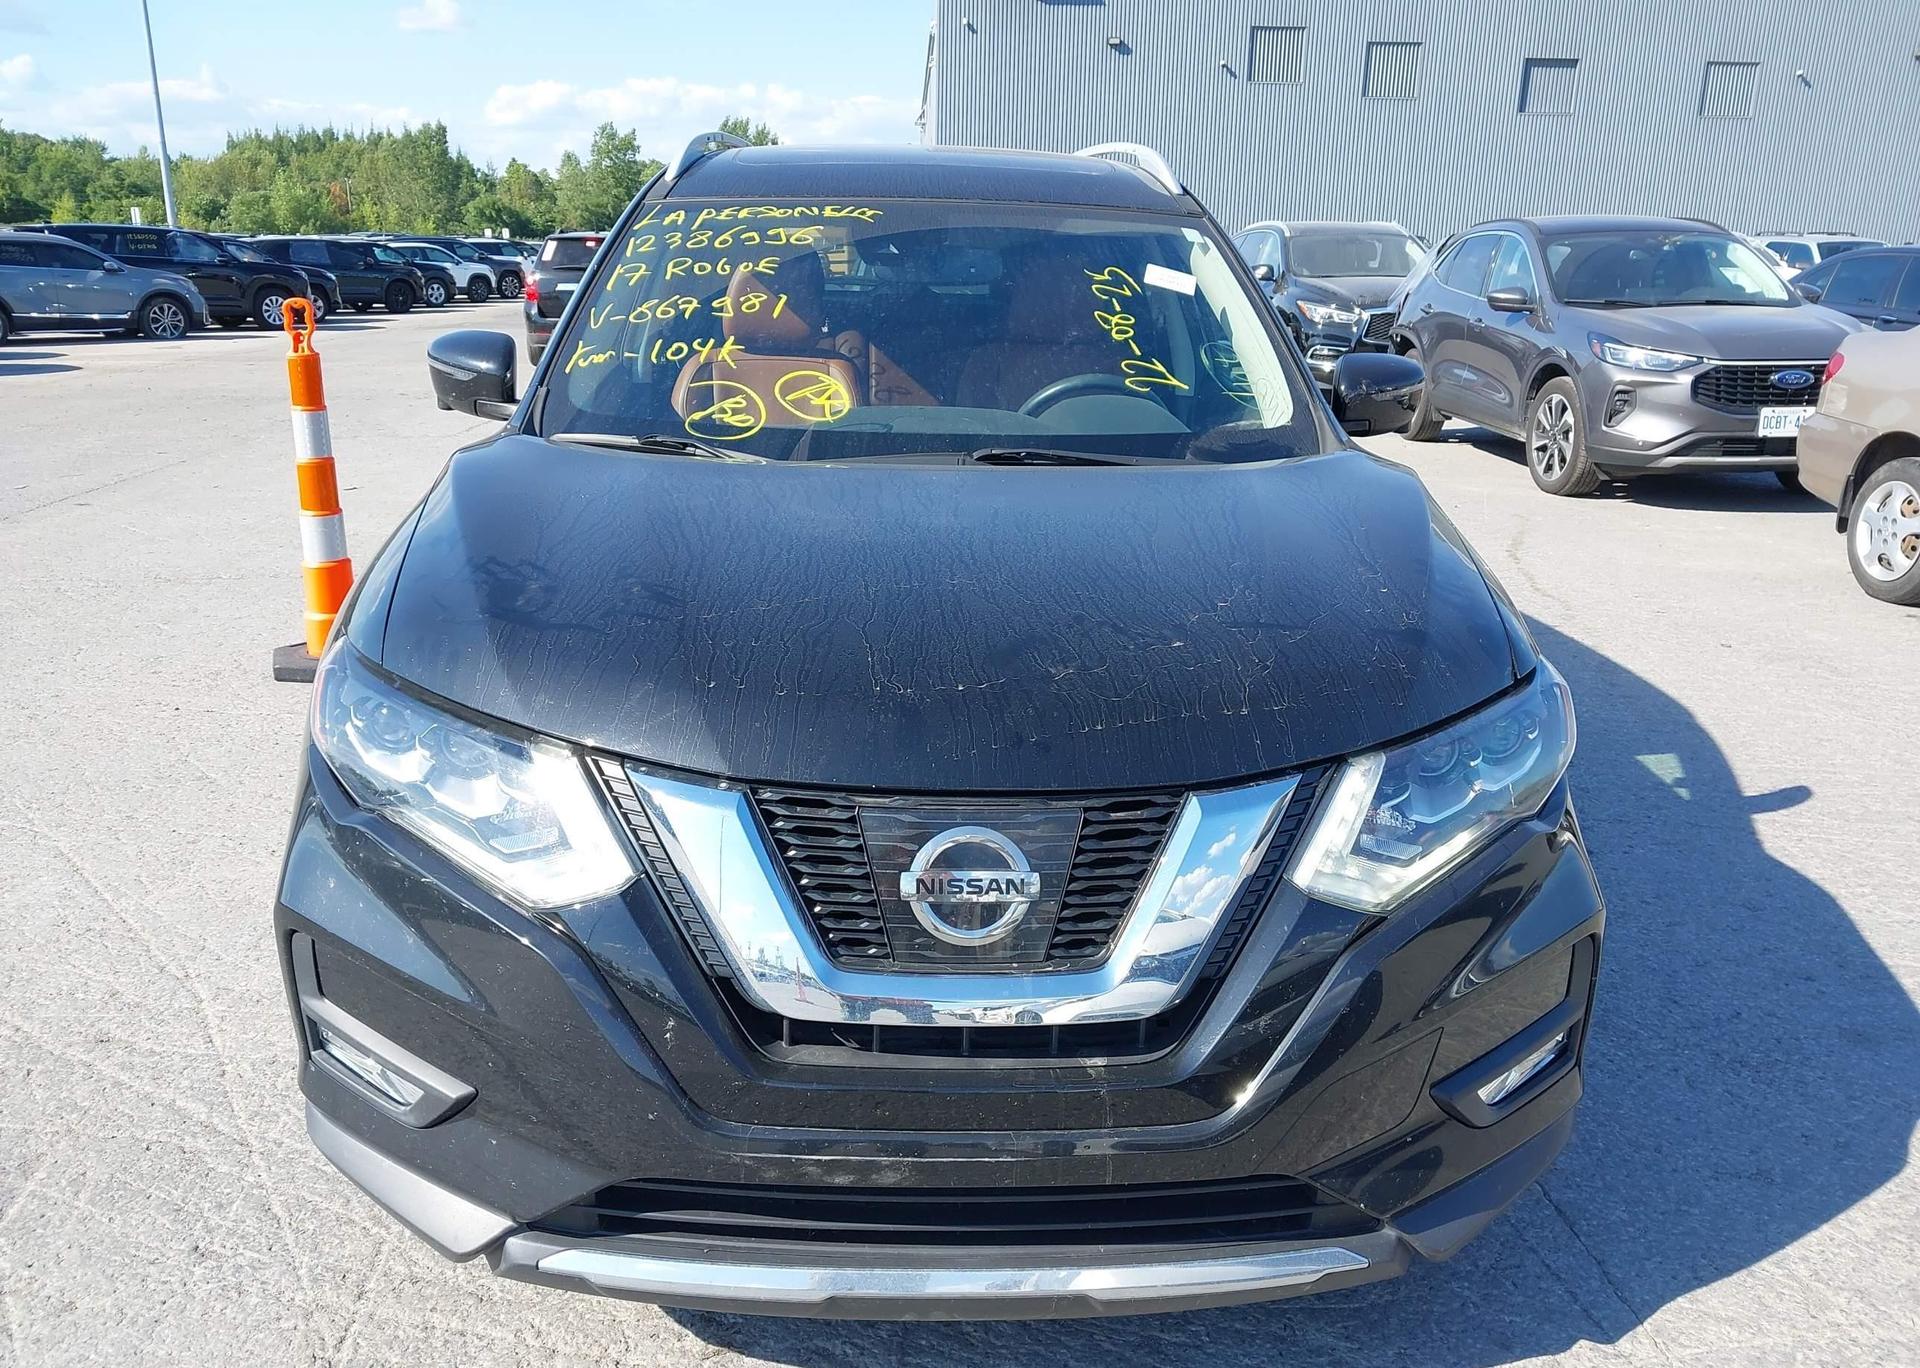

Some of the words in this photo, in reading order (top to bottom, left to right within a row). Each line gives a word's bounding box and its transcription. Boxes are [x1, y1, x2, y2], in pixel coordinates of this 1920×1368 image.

[633, 204, 686, 230] LA
[606, 263, 652, 291] 17
[915, 878, 1025, 895] NISSAN
